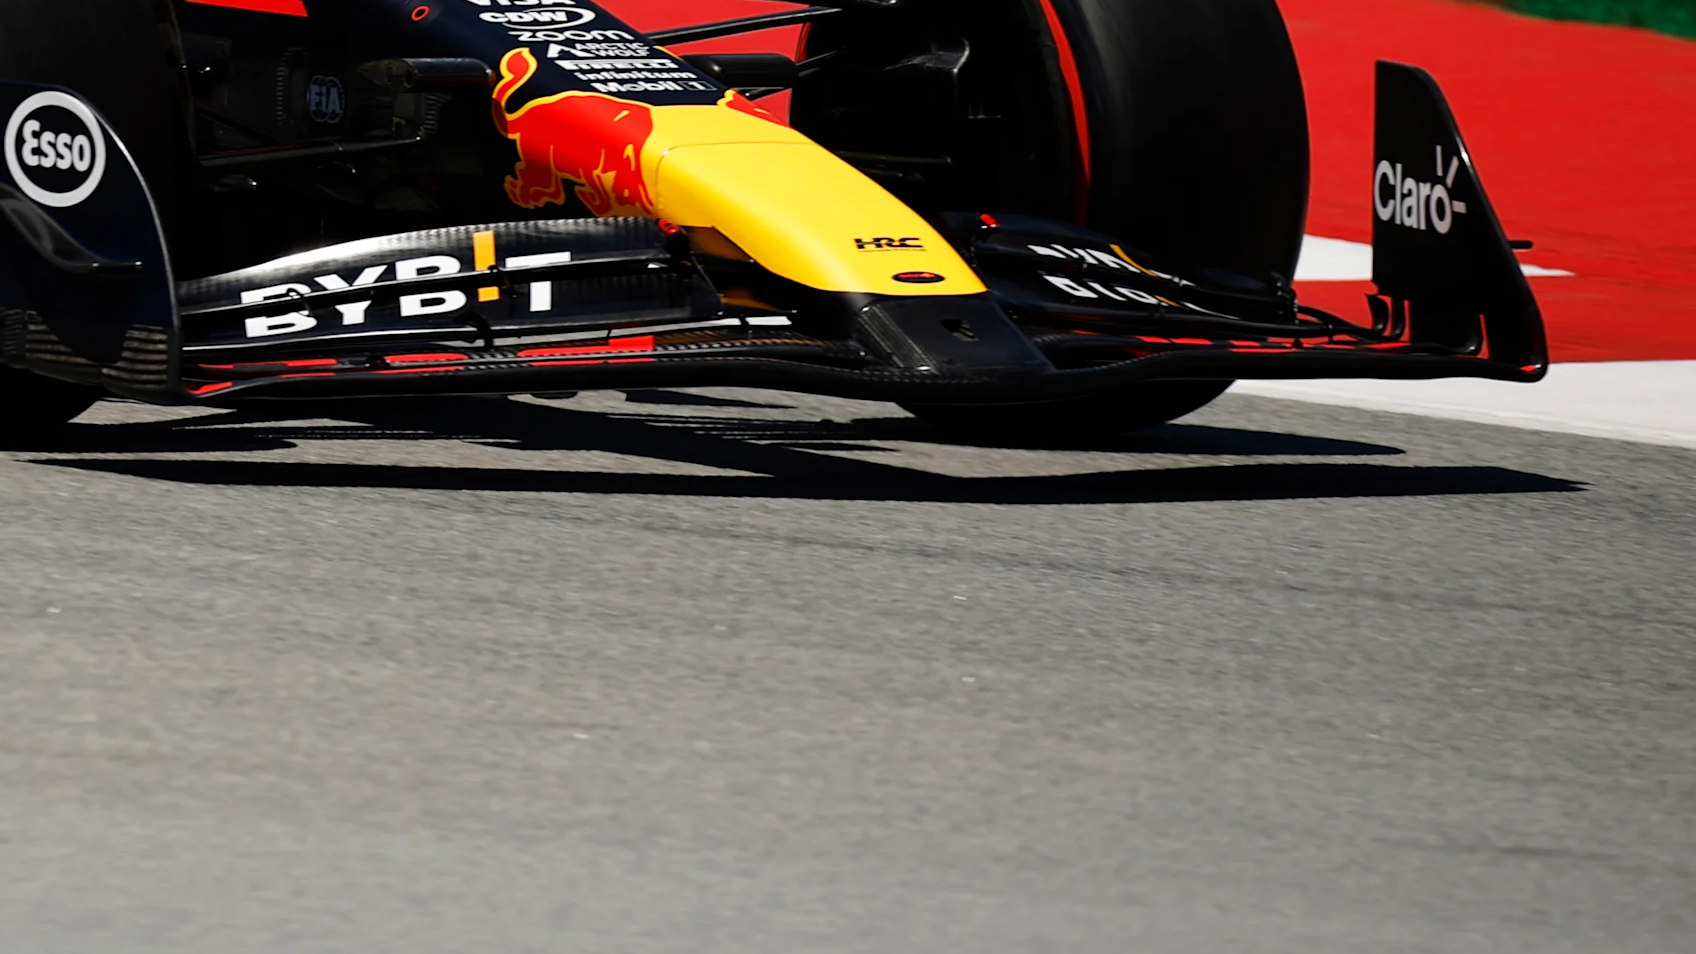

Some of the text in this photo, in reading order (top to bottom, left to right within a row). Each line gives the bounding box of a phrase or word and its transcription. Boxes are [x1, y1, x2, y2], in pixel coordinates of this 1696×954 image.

[478, 9, 570, 24] CDW
[507, 30, 636, 42] zoom
[590, 49, 651, 58] WOLF
[589, 81, 685, 93] Mobil
[21, 118, 92, 173] Esso
[1373, 159, 1453, 235] Claro
[853, 237, 924, 250] HRC
